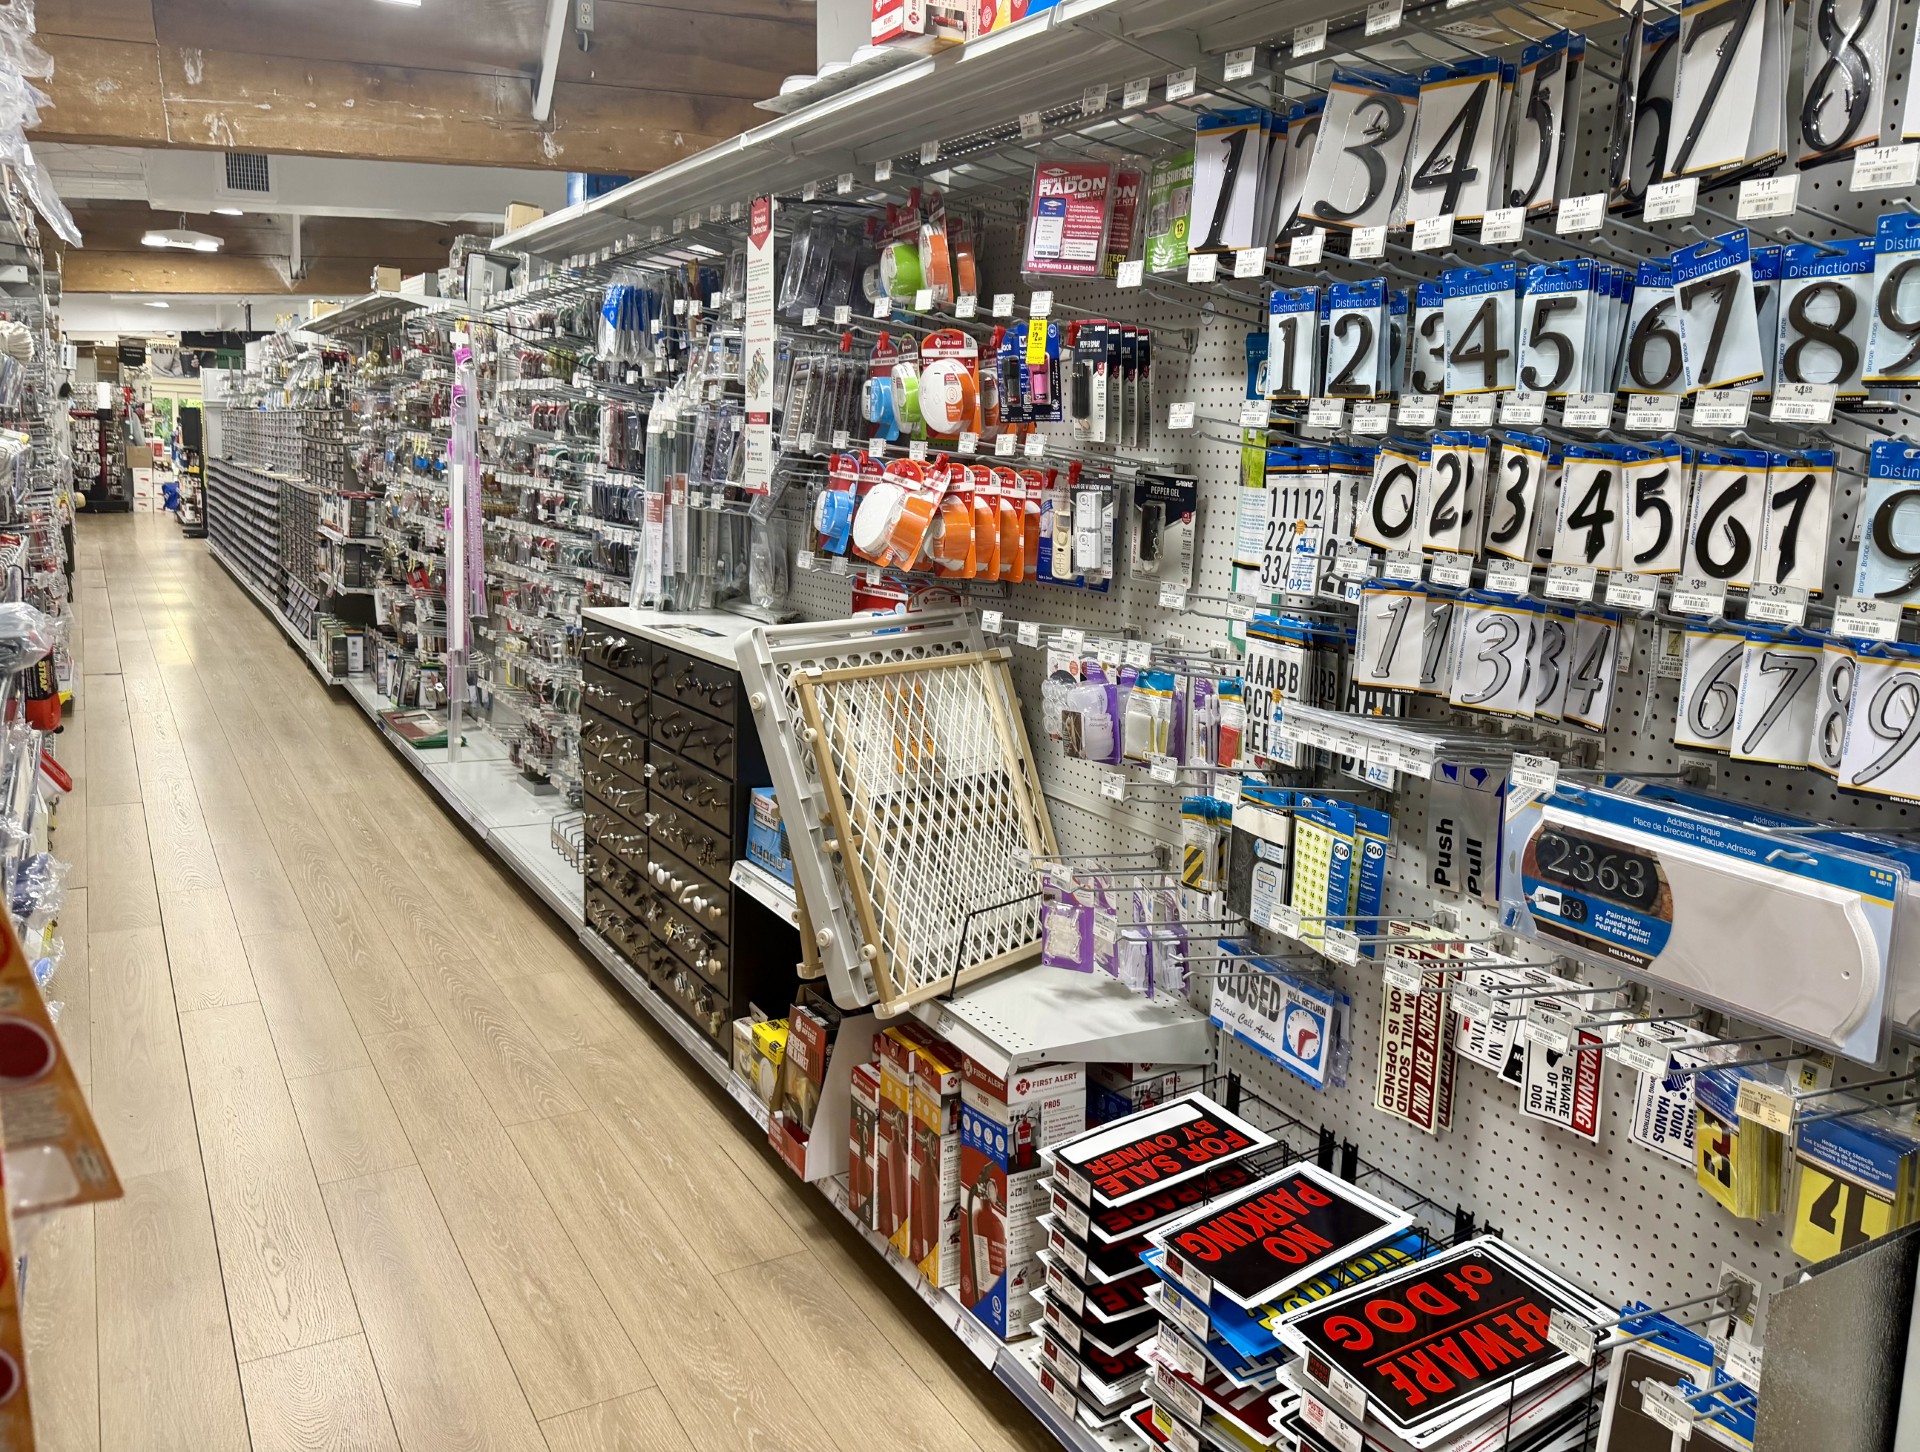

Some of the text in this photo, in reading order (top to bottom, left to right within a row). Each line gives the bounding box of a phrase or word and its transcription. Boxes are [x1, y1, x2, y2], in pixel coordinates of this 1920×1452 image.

[1671, 0, 1755, 175] 7
[1802, 0, 1878, 152] 8
[1411, 79, 1490, 214] 4
[1510, 51, 1562, 208] 5
[1313, 95, 1406, 220] 3
[1038, 176, 1106, 196] RADON
[1194, 129, 1248, 250] 1
[1449, 279, 1511, 297] Distinctions
[1530, 278, 1585, 293] Distinctions
[1678, 253, 1742, 280] Distinctions
[1790, 261, 1867, 278] Distinctions
[1274, 302, 1311, 313] Distinctions
[1336, 298, 1378, 308] Distinctions
[1450, 296, 1509, 388] 4
[1521, 297, 1577, 391] 5
[1629, 296, 1684, 388] 6
[1680, 270, 1742, 385] 7
[1783, 282, 1860, 384] 8
[1272, 317, 1300, 396] 1
[1328, 312, 1372, 394] 2
[1150, 486, 1180, 498] PEPPER GEL
[1428, 452, 1462, 538] 2
[1490, 454, 1530, 543] 3
[1567, 470, 1614, 564] 4
[1634, 468, 1672, 564] 5
[1694, 474, 1751, 579] 6
[1288, 578, 1302, 592] 0-9
[1372, 596, 1412, 678] 1
[1460, 613, 1520, 704] 3
[1571, 624, 1612, 714] 4
[1688, 640, 1744, 738] 6
[1742, 651, 1818, 754] 7
[1818, 656, 1856, 768] 8
[1852, 672, 1920, 786] 9
[1270, 746, 1284, 760] A-Z
[1368, 766, 1382, 781] A-Z
[1633, 816, 1756, 857] Place de Dirección Plaque-Adresse
[1666, 816, 1720, 838] Address Plaque
[1334, 846, 1350, 858] 600
[1367, 846, 1383, 856] 600
[1434, 818, 1454, 887] Push
[1466, 838, 1482, 898] Pull
[1548, 832, 1646, 898] 2363
[1561, 899, 1583, 920] 63
[1594, 914, 1652, 938] Se puede Pintar!
[1606, 910, 1641, 926] Paintable!
[1595, 922, 1650, 945] Peut être peint!
[1608, 946, 1644, 964] HILLMAN
[1216, 952, 1282, 1023] CLOSED
[1302, 998, 1327, 1017] RETURN
[1213, 998, 1276, 1044] Please Call Again
[1382, 1018, 1399, 1108] IS OPENED
[1396, 1006, 1414, 1113] WILL SOUND
[1416, 1050, 1432, 1082] EXIT
[1487, 1040, 1504, 1061] NO
[972, 1068, 1004, 1091] FIRST ALERT
[1032, 1072, 1078, 1088] FIRST ALERT
[1530, 1084, 1542, 1108] DOG
[1544, 1071, 1558, 1114] OF THE
[1559, 1066, 1574, 1119] BEWARE
[1576, 1030, 1602, 1130] WARNING
[1412, 1082, 1430, 1128] ONLY
[1642, 1108, 1652, 1138] RESTROOM
[1652, 1096, 1671, 1144] HANDS
[1669, 1104, 1686, 1140] YOUR
[1084, 1120, 1219, 1176] BY OWNER
[1177, 1130, 1250, 1162] FOR
[1683, 1108, 1697, 1150] WASH
[1821, 1138, 1874, 1166] Heavy Duty Stencils
[1094, 1155, 1182, 1197] SALE
[1804, 1136, 1892, 1180] Los Estarcidos de Servicio Pesado
[1841, 1158, 1858, 1172] Usage
[1858, 1164, 1880, 1180] Intensif
[1866, 1190, 1892, 1204] HILLMAN
[1174, 1179, 1332, 1262] PARKING
[1262, 1223, 1334, 1264] NO
[1323, 1264, 1494, 1350] of DOG
[1377, 1302, 1553, 1407] BEWARE
